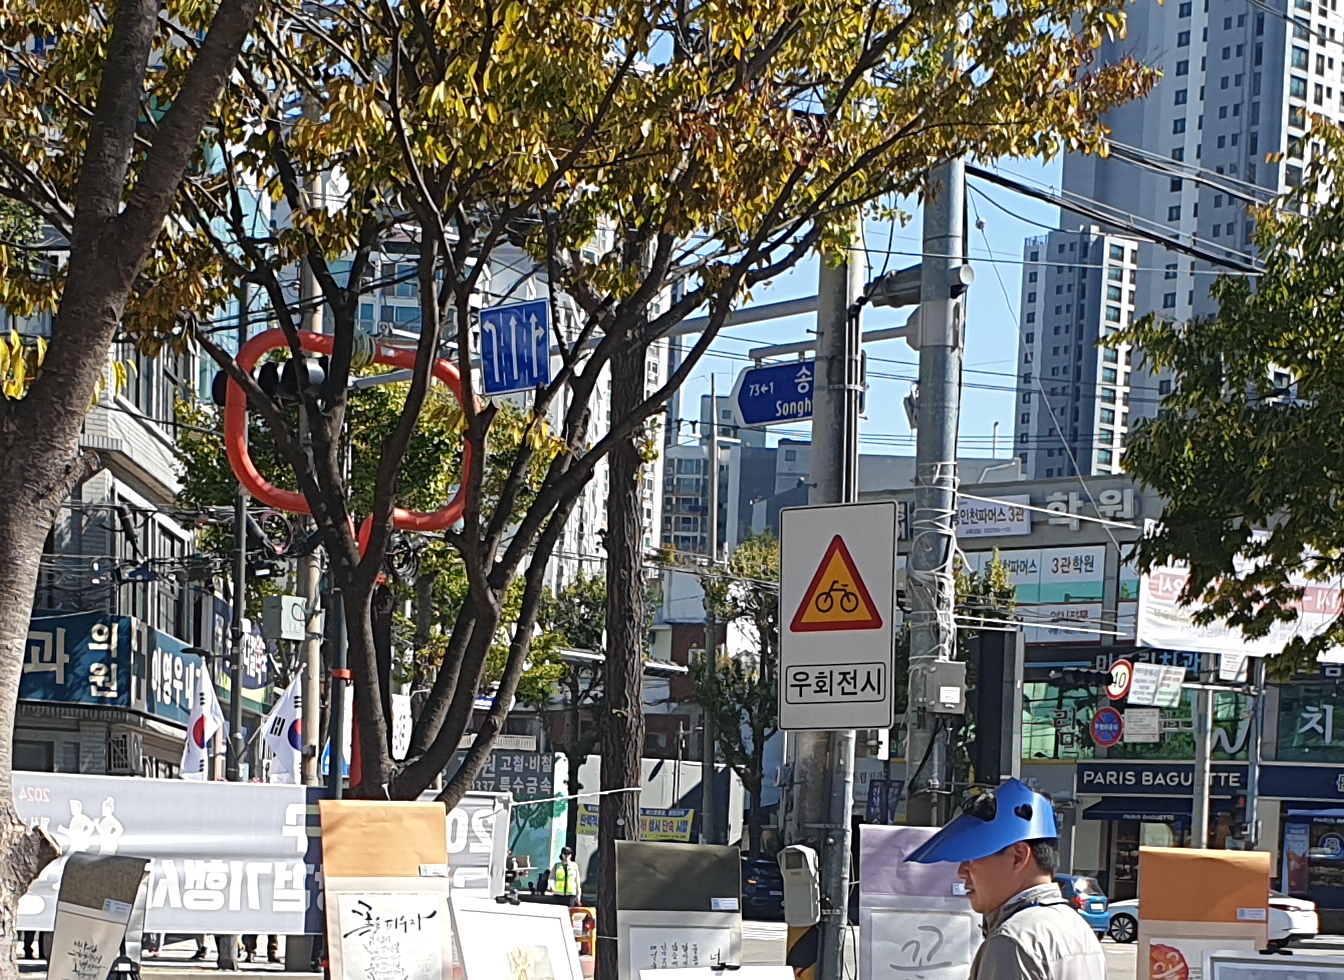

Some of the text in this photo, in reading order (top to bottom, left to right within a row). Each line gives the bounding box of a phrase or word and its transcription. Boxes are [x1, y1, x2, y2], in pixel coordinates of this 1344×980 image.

[88, 622, 119, 698] 의원
[152, 646, 202, 709] 이영우내
[790, 668, 882, 698] 우회전시
[498, 776, 553, 795] 특수금속
[1083, 771, 1241, 787] PARIS BAGUTTE
